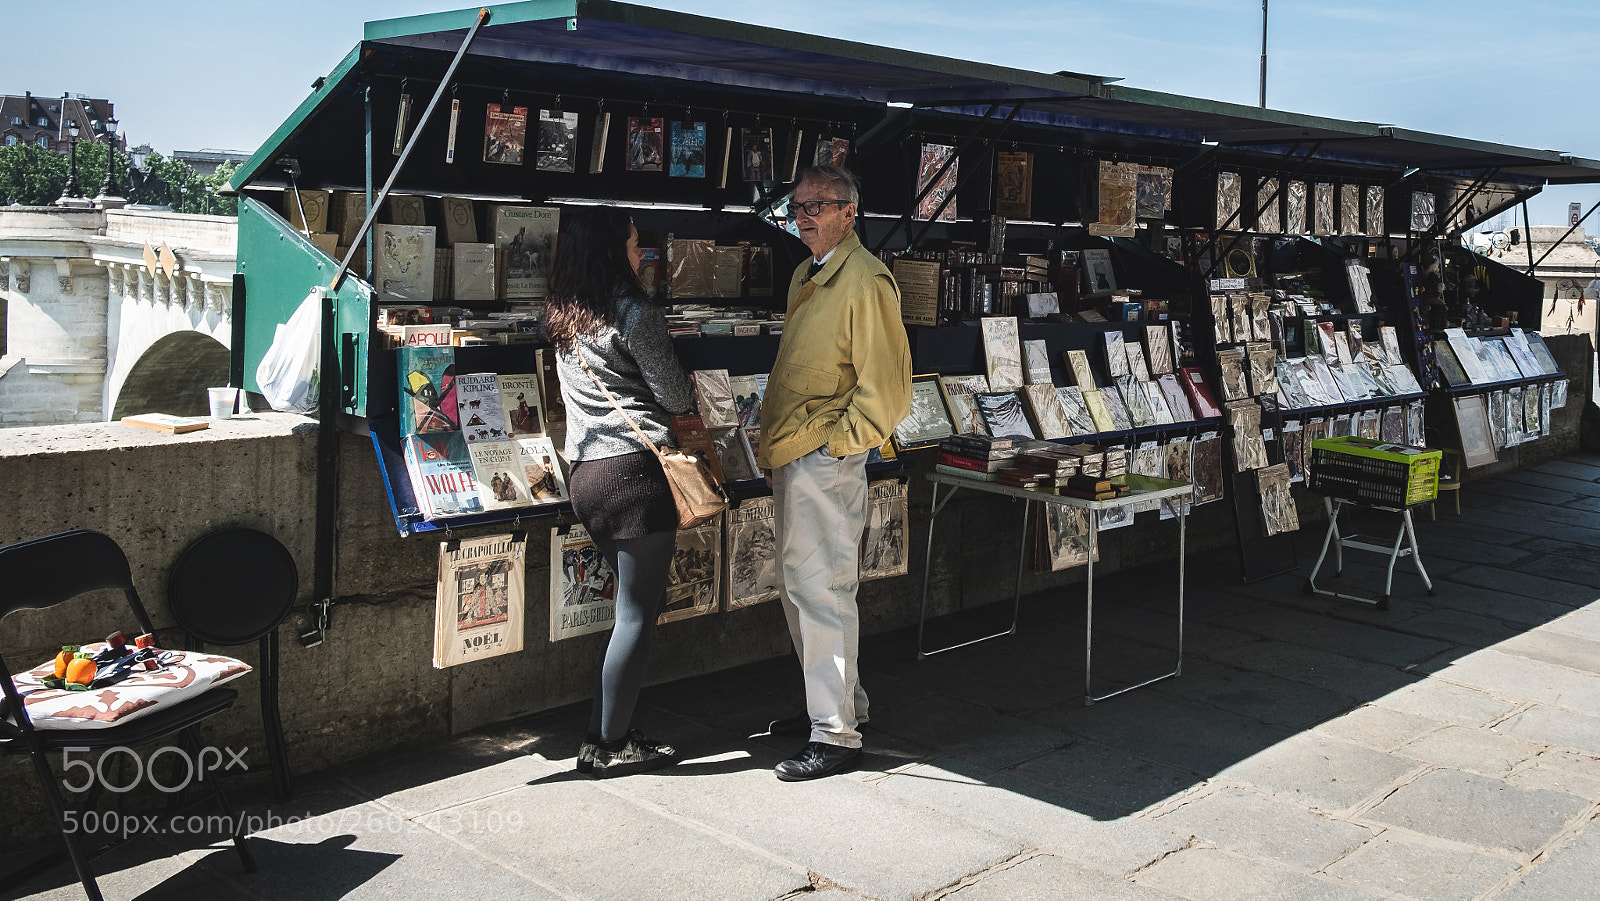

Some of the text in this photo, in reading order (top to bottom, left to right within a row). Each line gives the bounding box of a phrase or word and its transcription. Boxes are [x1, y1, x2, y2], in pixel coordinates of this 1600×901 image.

[504, 209, 533, 218] Gustave
[458, 376, 496, 385] RUDYARD
[463, 384, 495, 393] KIPLING
[483, 448, 513, 456] VOYAGE
[519, 446, 549, 456] ZOLA
[425, 471, 478, 495] WOLFE
